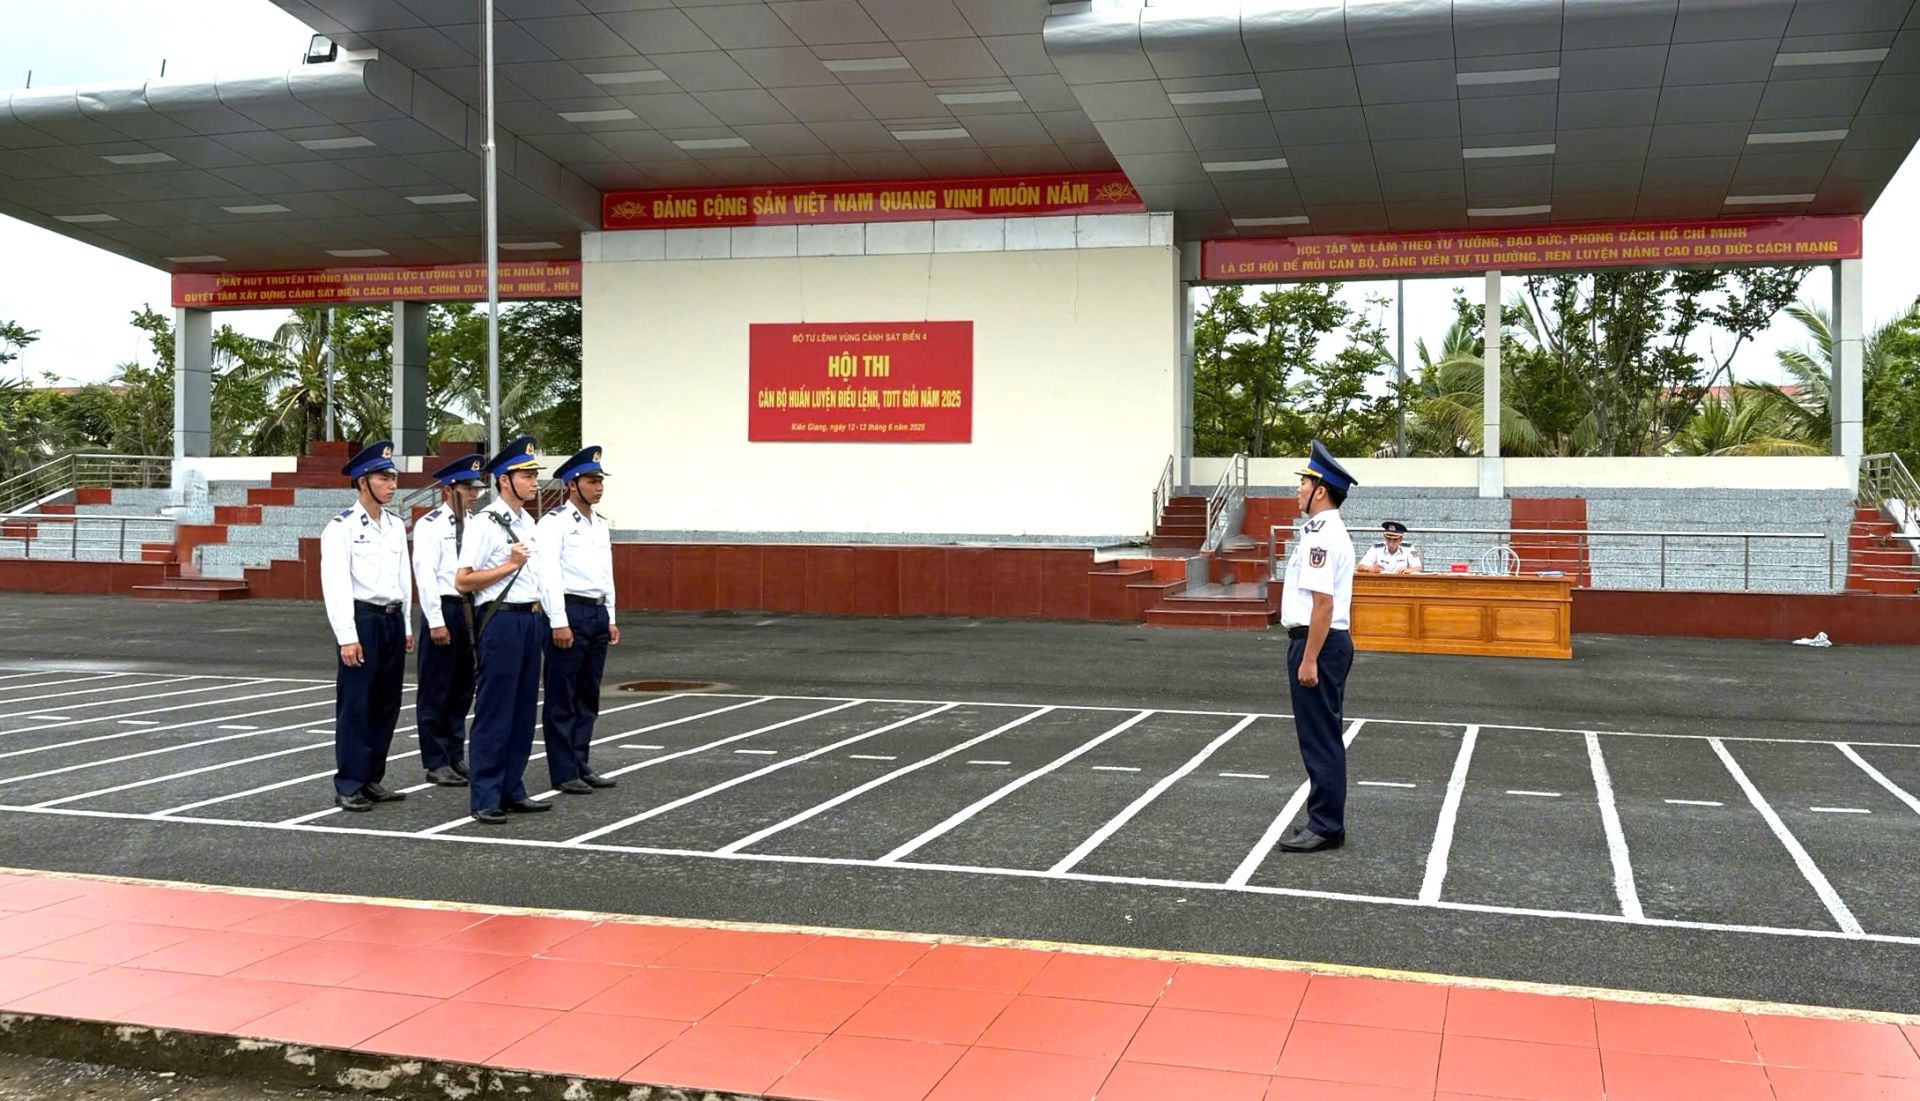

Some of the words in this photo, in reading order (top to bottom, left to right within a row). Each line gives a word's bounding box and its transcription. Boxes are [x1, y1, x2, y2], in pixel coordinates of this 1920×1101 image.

[653, 194, 697, 218] ĐẢNG
[703, 194, 747, 220] CỘNG
[753, 190, 786, 215] SẢN
[793, 191, 827, 216] VIỆT
[834, 193, 873, 212] NAM
[880, 190, 936, 212] QUANG
[943, 188, 982, 208] VINH
[989, 182, 1039, 207] MUÔN
[1047, 181, 1089, 204] NĂM
[1297, 245, 1320, 257] HỌC
[1325, 242, 1347, 256] TẬP
[1351, 242, 1365, 253] VÀ
[1370, 240, 1398, 252] LÀM
[1401, 240, 1431, 251] THEO
[1437, 238, 1453, 250] TƯ
[1507, 236, 1532, 248] ĐẠO
[1570, 233, 1613, 244] PHONG
[1620, 229, 1655, 242] CÁCH
[1683, 228, 1705, 240] CHÍ
[1711, 228, 1747, 239] MINH
[1221, 262, 1235, 274] LÀ
[1240, 262, 1255, 273] CƠ
[1259, 260, 1278, 273] HỘI
[1382, 254, 1416, 267] ĐẢNG
[1421, 254, 1449, 265] VIÊN
[1454, 254, 1470, 266] TỰ
[1475, 253, 1489, 264] TU
[1545, 249, 1571, 261] RÈN
[1576, 247, 1618, 261] LUYỆN
[1622, 245, 1660, 258] NÂNG
[1664, 246, 1690, 256] CAO
[1694, 245, 1721, 257] ĐẠO
[1725, 242, 1753, 255] ĐỨC
[1756, 241, 1792, 254] CÁCH
[1796, 241, 1838, 254] MẠNG
[244, 277, 263, 286] HUY
[343, 273, 364, 282] ANH
[397, 270, 418, 281] LỰC
[475, 268, 511, 279] TRNG
[184, 290, 213, 302] QUYẾT
[240, 289, 257, 300] XÂY
[260, 290, 286, 301] DỰNG
[288, 287, 315, 299] CẢNH
[429, 283, 459, 294] CHÍNH
[792, 333, 804, 343] BỘ
[806, 334, 816, 342] TƯ
[817, 333, 837, 343] LỆNH
[840, 332, 860, 342] VÙNG
[862, 331, 883, 342] CẢNH
[828, 351, 858, 382] HỘI
[863, 355, 890, 377] THI
[759, 387, 775, 408] CÁN
[777, 387, 787, 412] BỘ
[789, 384, 810, 408] HUẤN
[812, 386, 836, 412] LUYỆN
[883, 390, 901, 408] TDTT
[903, 384, 919, 408] GIỎI
[921, 386, 940, 408] NĂM
[942, 390, 961, 408] 2025
[791, 423, 806, 431] Kiên
[830, 424, 846, 432] ngày
[868, 423, 887, 432] tháng
[909, 423, 925, 431] 2025
